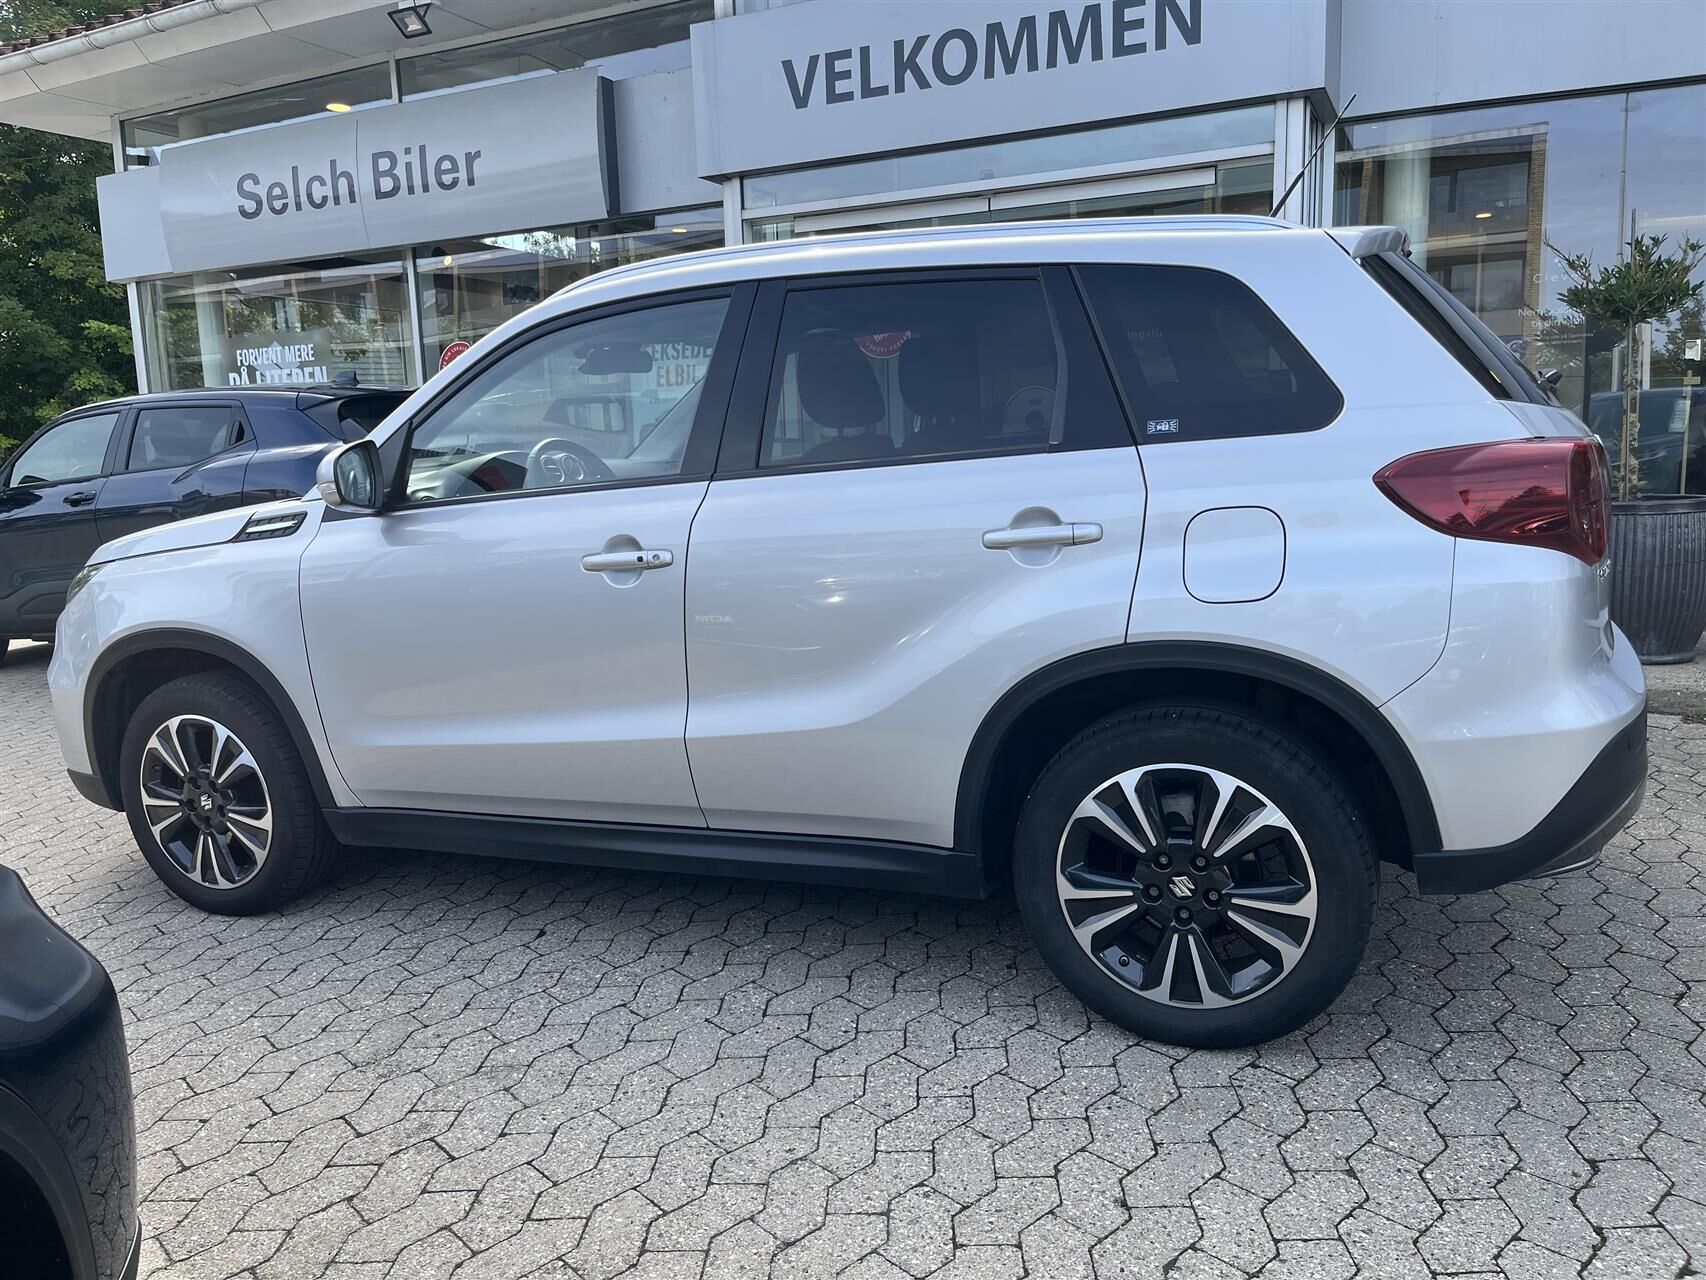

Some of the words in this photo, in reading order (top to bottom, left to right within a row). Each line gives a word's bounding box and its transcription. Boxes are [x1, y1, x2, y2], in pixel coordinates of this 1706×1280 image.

[781, 0, 1201, 110] VELKOMMEN
[236, 158, 357, 220] Selch
[371, 143, 482, 201] Biler
[1532, 271, 1579, 284] Cleve
[236, 346, 282, 366] FORVENT
[284, 344, 315, 363] MERE
